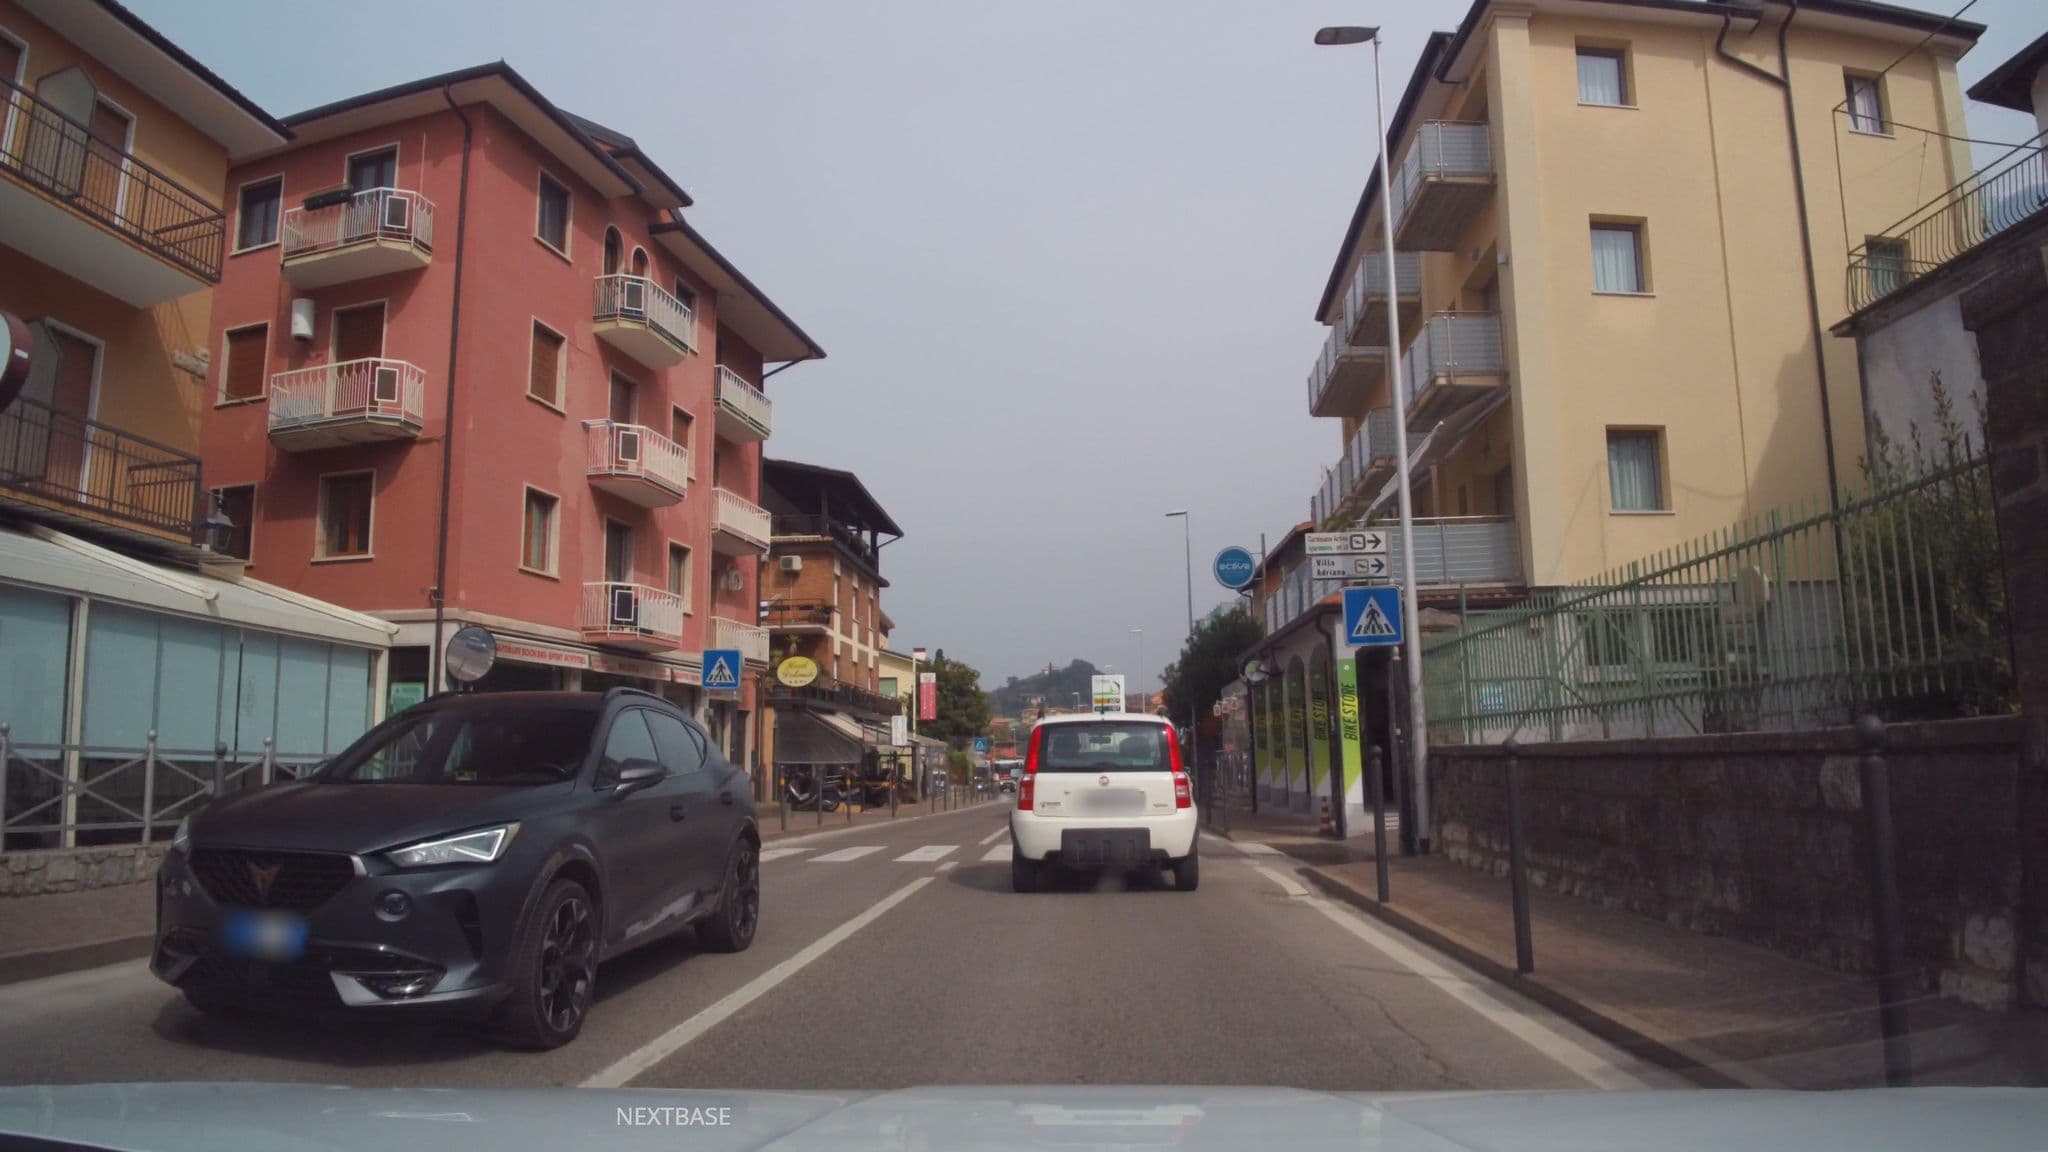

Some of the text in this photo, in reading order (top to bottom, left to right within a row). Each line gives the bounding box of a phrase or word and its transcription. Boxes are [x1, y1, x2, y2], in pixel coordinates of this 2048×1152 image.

[1316, 569, 1346, 577] Adriana
[1341, 682, 1359, 741] BIKE STORE
